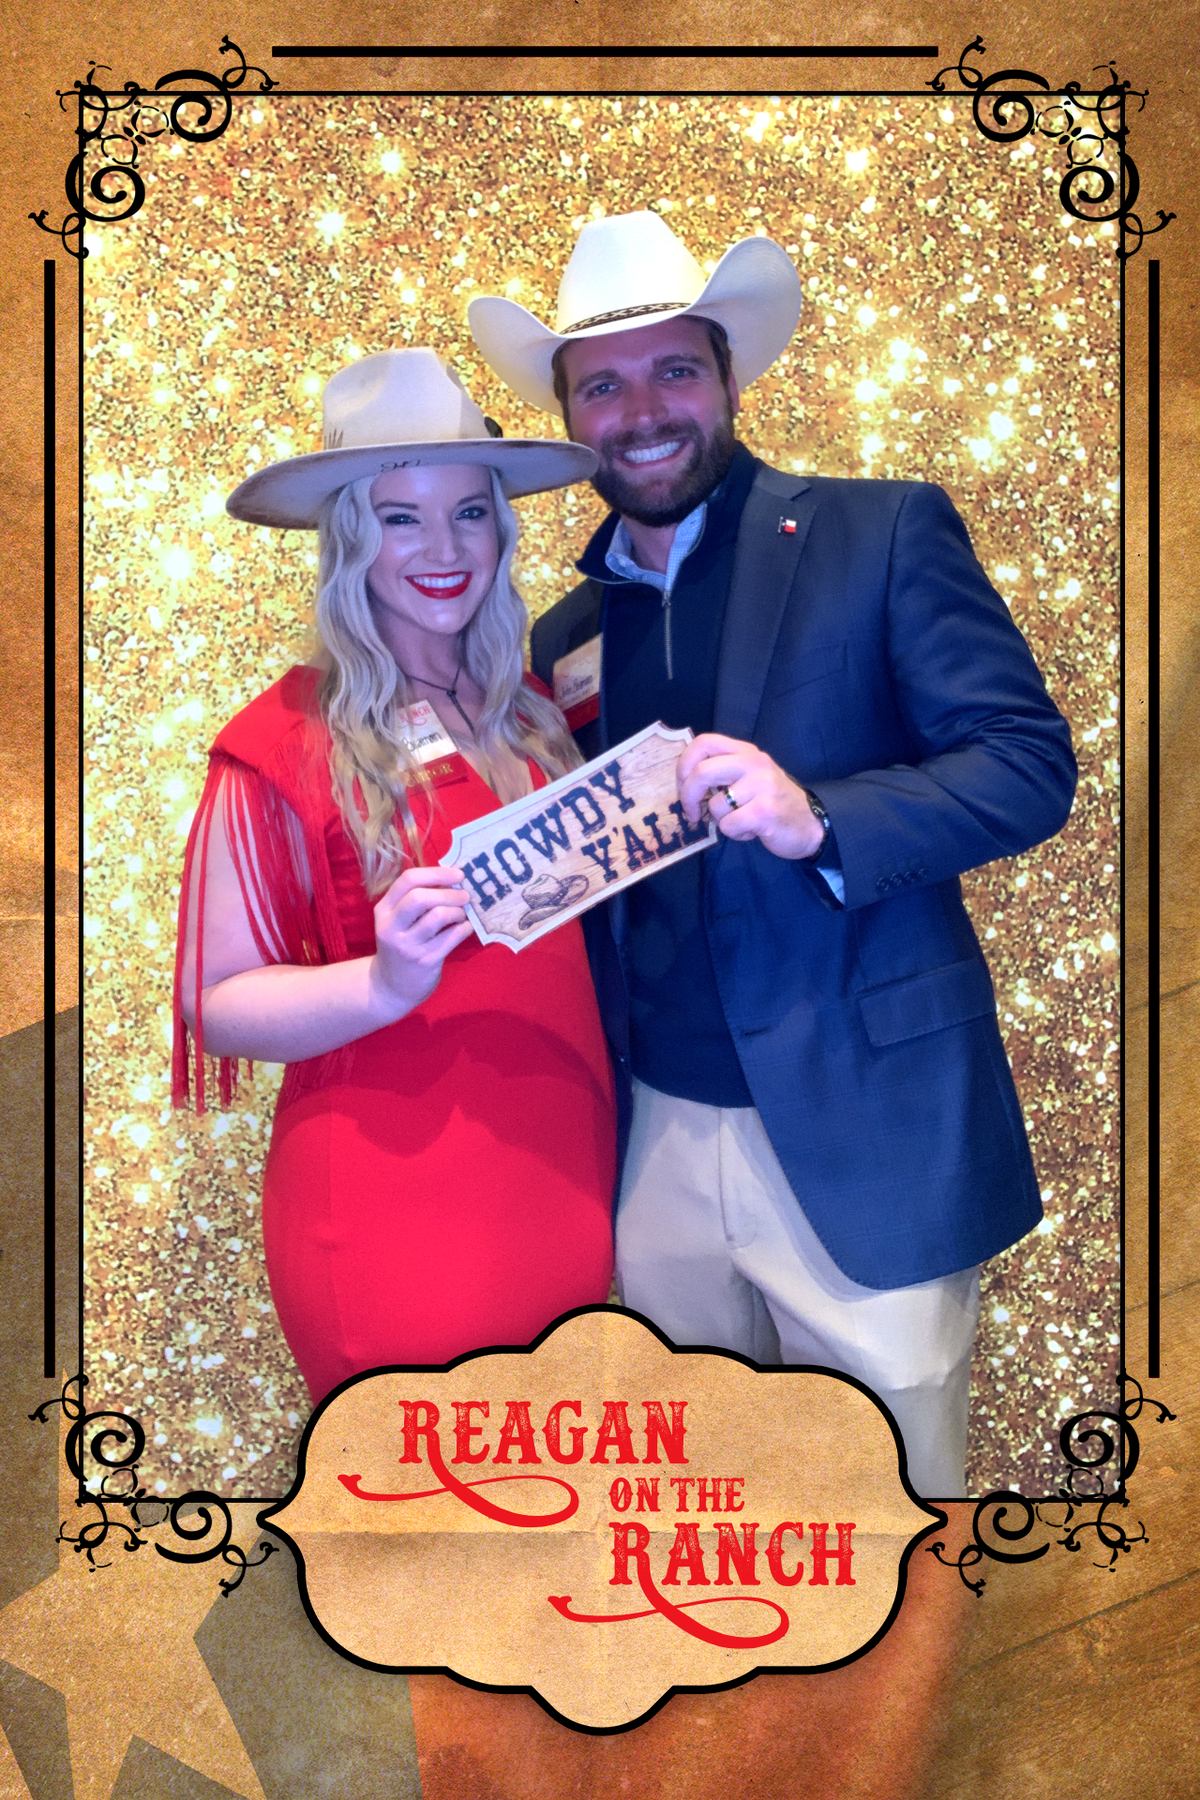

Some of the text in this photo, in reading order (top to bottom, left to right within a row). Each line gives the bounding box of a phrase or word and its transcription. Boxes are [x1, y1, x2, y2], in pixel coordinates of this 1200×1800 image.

[399, 705, 430, 724] RNCH
[462, 760, 635, 911] HOWDY
[581, 801, 710, 883] Y'ALL
